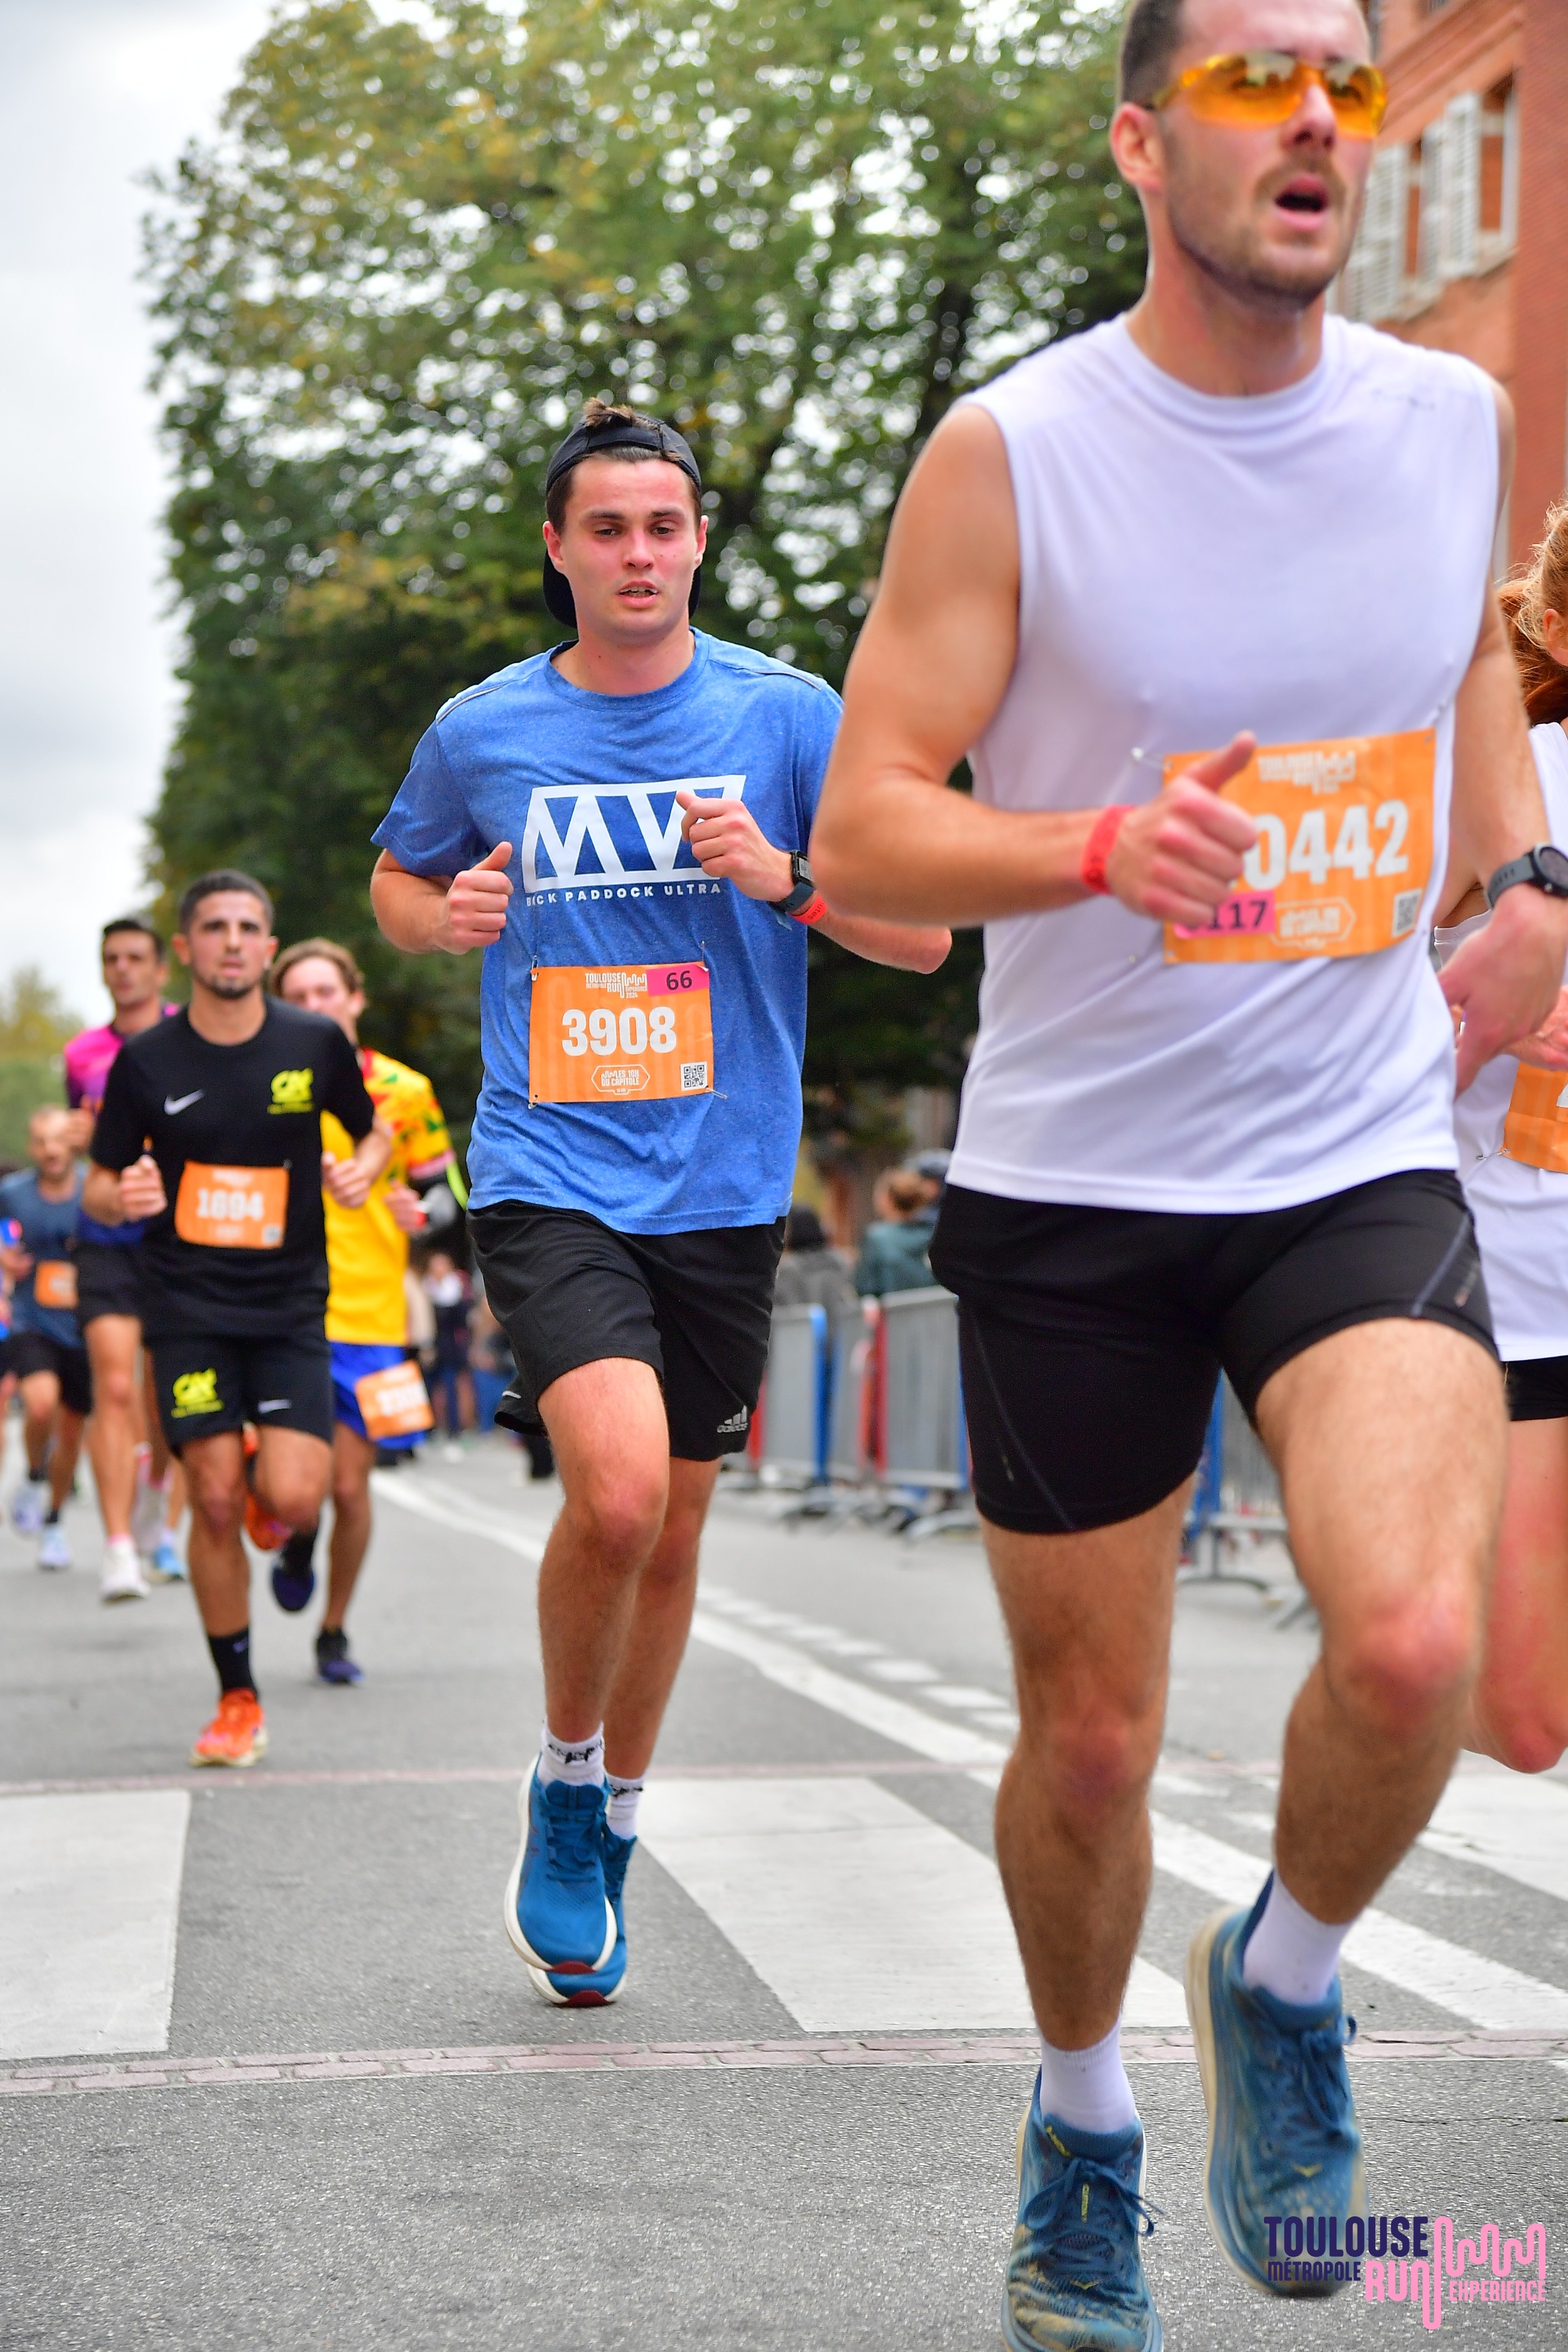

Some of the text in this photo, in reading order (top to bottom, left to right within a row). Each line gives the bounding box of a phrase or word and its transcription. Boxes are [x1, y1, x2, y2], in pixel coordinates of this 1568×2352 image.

[1228, 799, 1410, 890] 0442
[565, 885, 654, 902] PADDOCK
[665, 883, 721, 896] ULTRA
[1187, 899, 1268, 933] 117
[585, 972, 621, 983] TOULOUSE
[666, 970, 693, 991] 66
[562, 1006, 676, 1057] 3908
[611, 1077, 640, 1086] CAPITOLE
